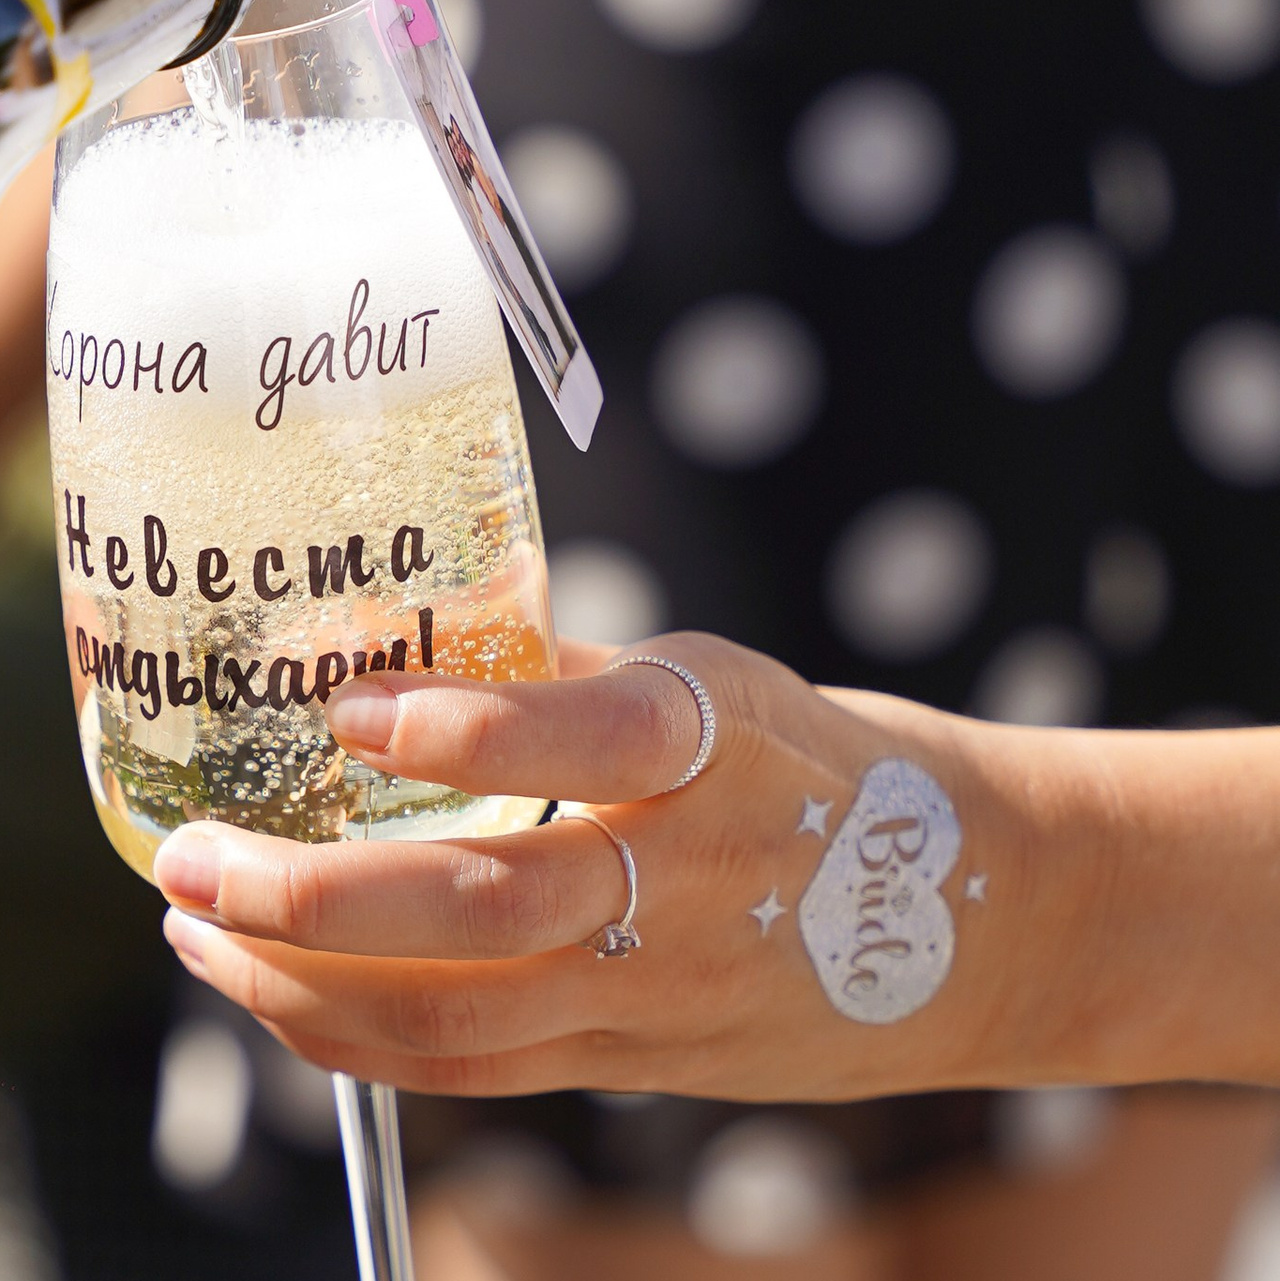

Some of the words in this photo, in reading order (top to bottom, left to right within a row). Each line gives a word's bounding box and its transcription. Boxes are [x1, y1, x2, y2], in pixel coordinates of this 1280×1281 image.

[255, 278, 441, 431] давит
[64, 488, 434, 603] Невеста
[842, 816, 929, 1002] Bride
